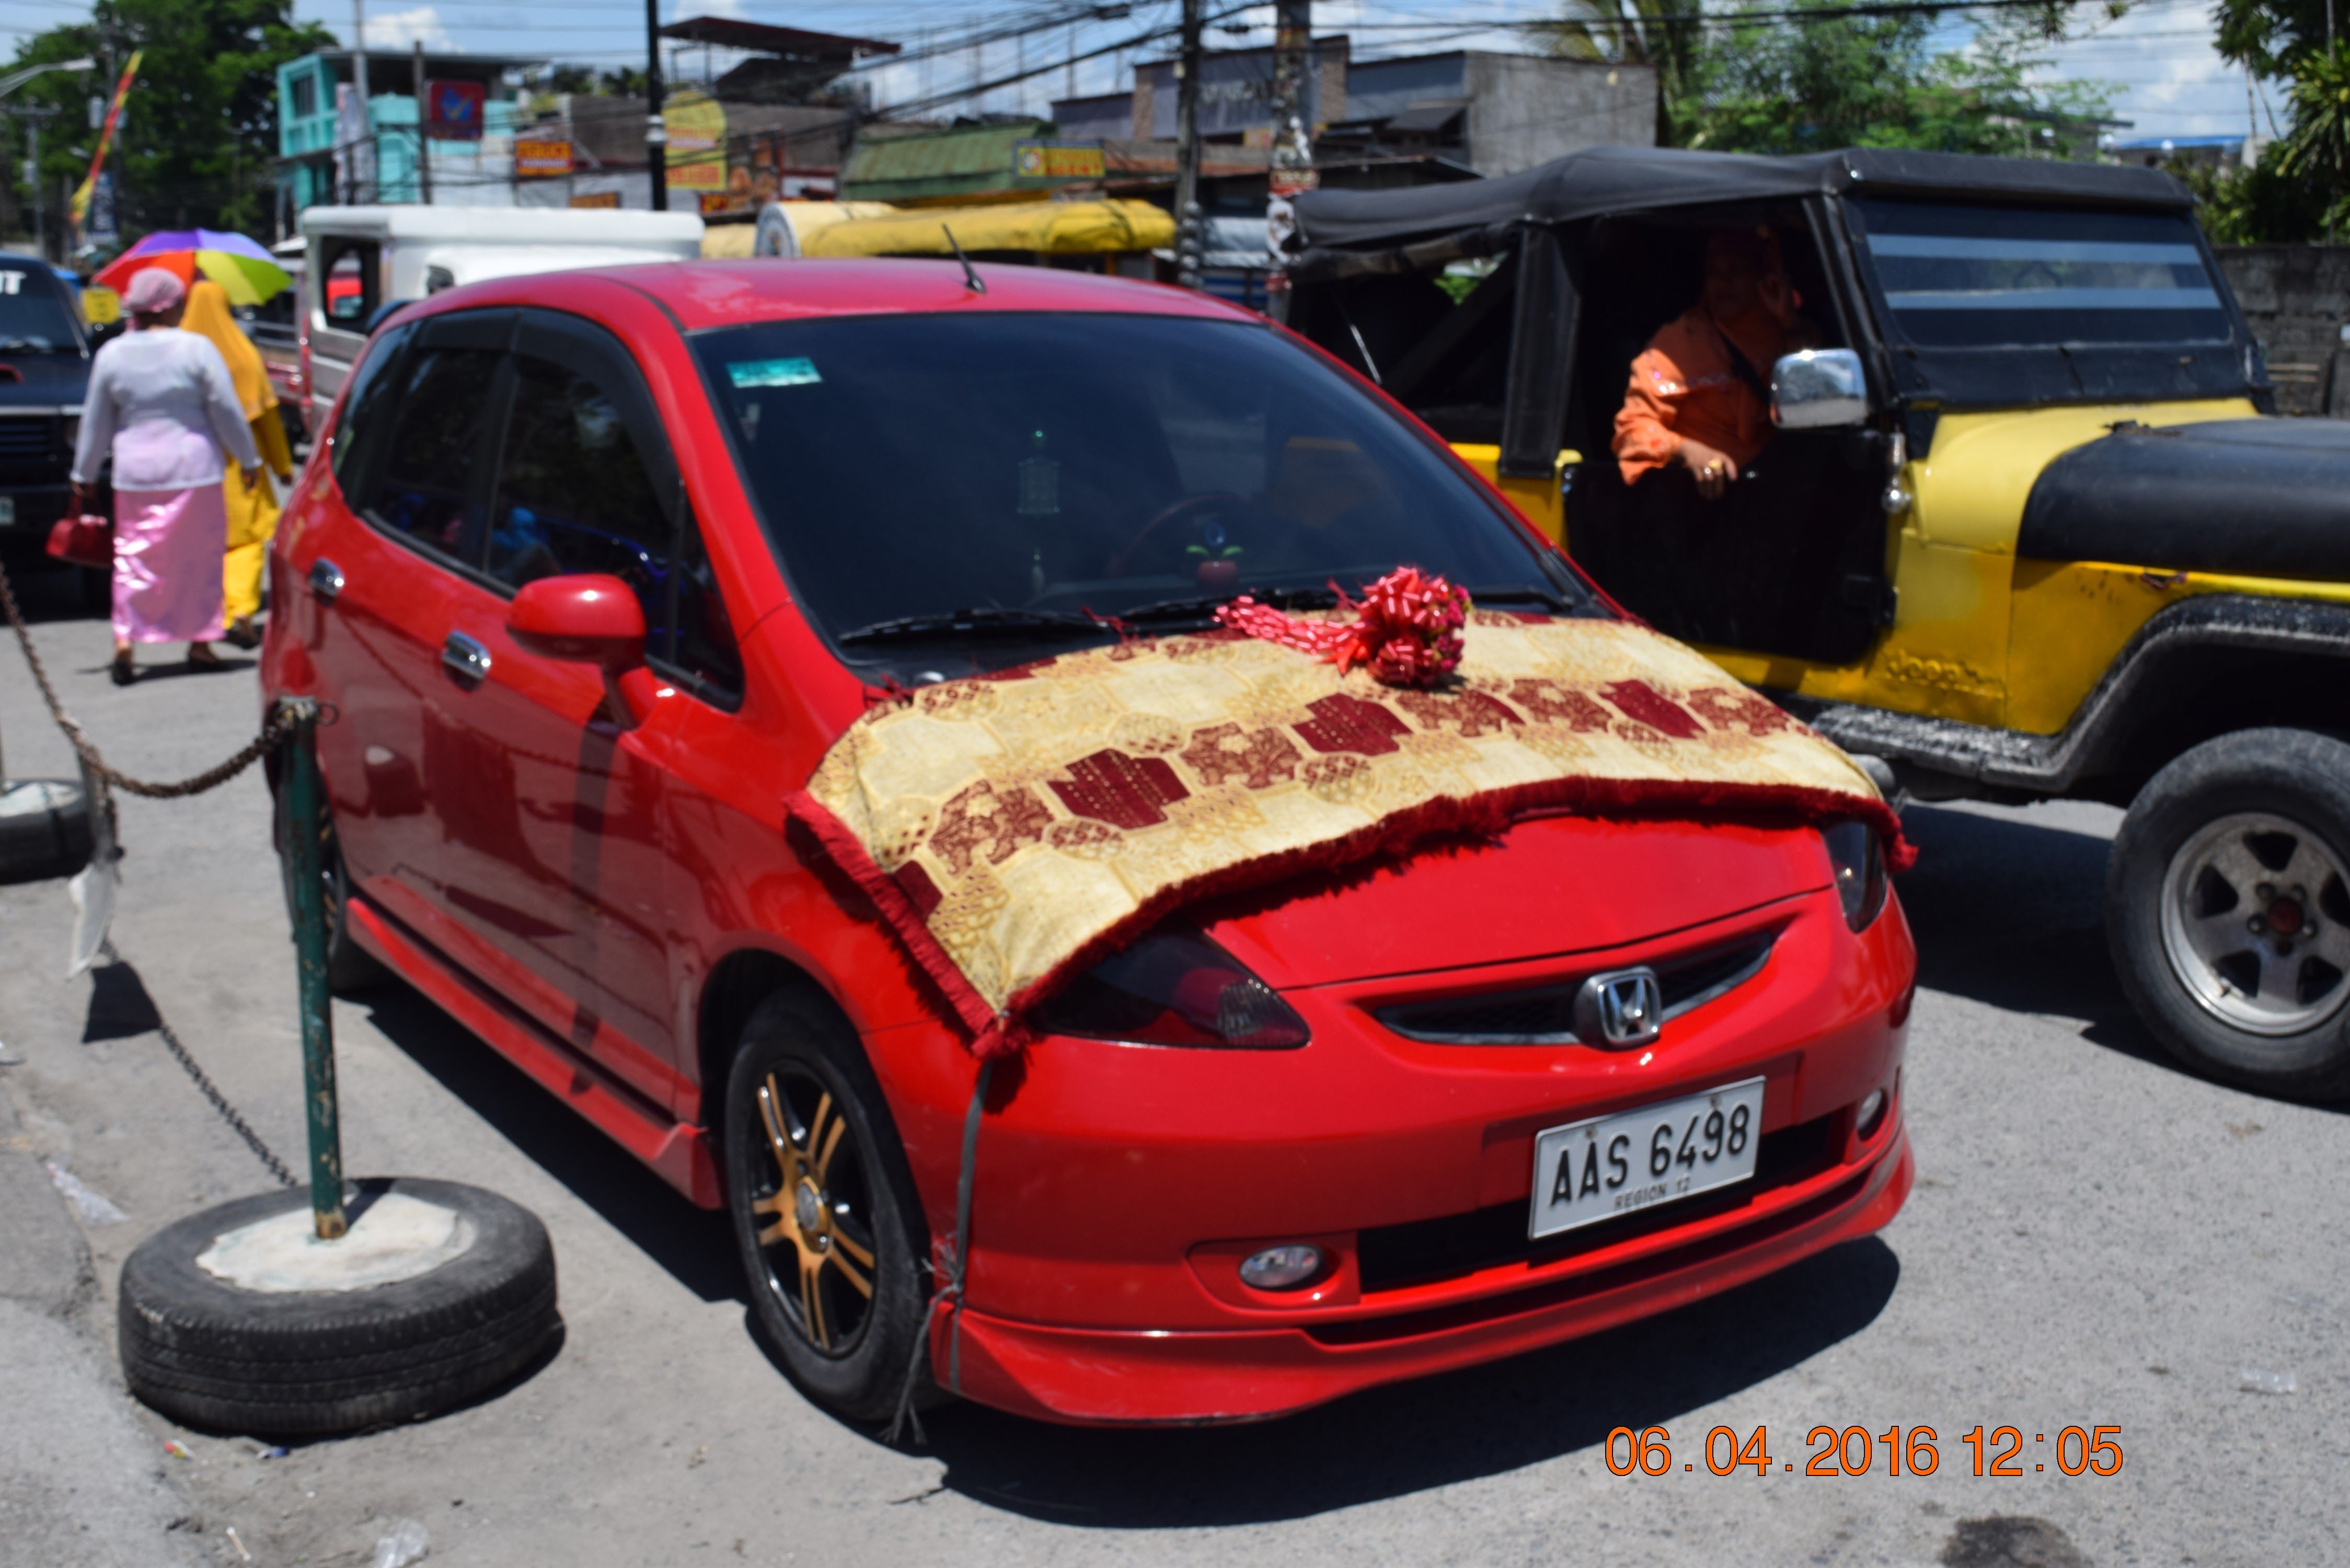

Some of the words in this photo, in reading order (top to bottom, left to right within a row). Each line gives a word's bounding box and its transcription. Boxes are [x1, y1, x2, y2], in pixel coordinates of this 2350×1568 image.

[1549, 1135, 1630, 1207] AAS
[1650, 1104, 1749, 1177] 6498
[1614, 1182, 1667, 1210] REGION
[1676, 1176, 1690, 1193] 12
